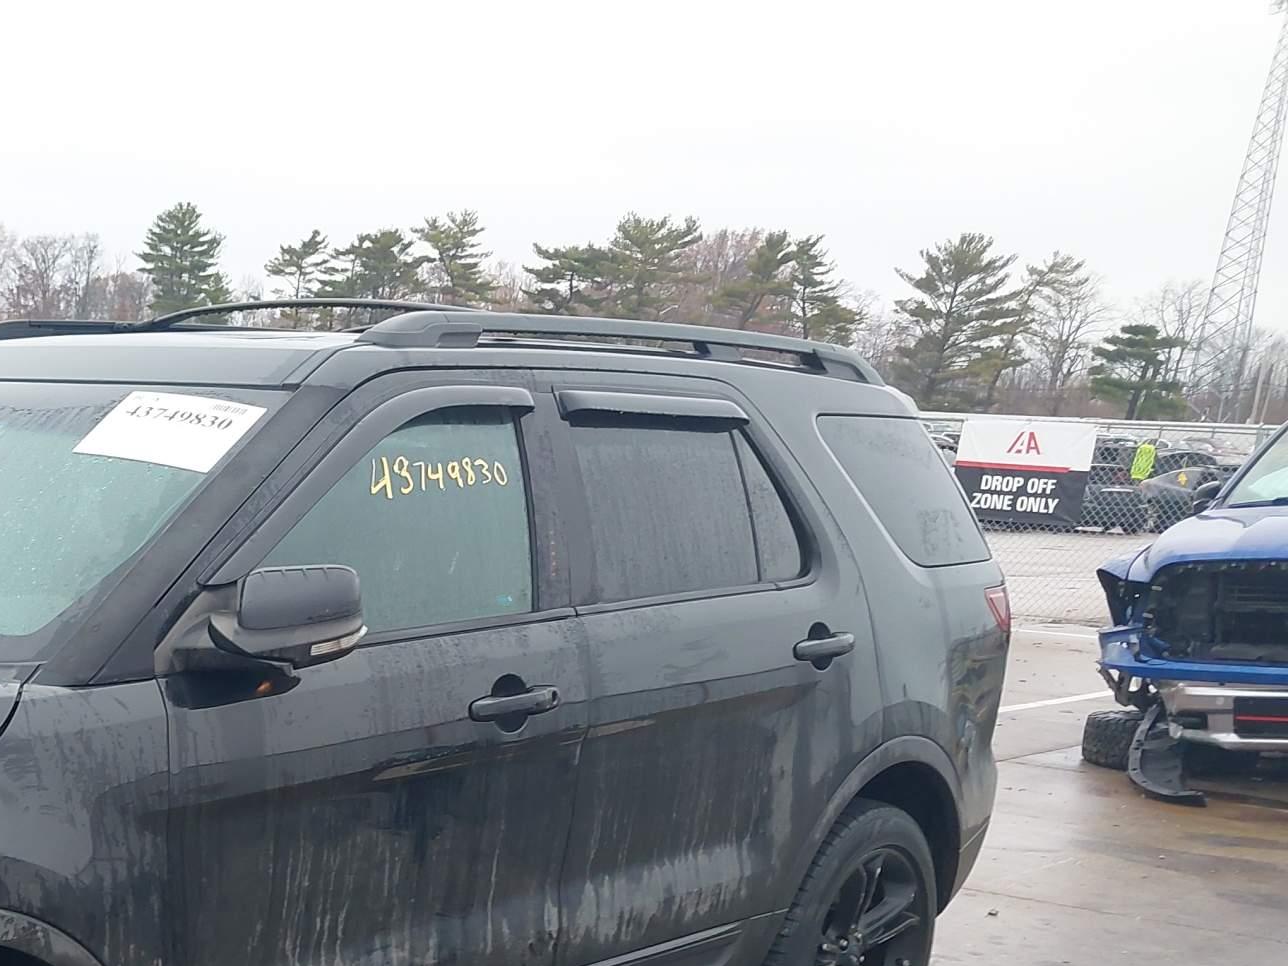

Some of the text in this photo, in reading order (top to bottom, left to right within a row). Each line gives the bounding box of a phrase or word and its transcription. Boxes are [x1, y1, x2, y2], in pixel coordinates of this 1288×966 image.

[125, 405, 233, 430] 43749830
[370, 455, 508, 499] 43749830
[980, 475, 1057, 494] DROP OFF
[970, 492, 1059, 514] ZONE ONLY
